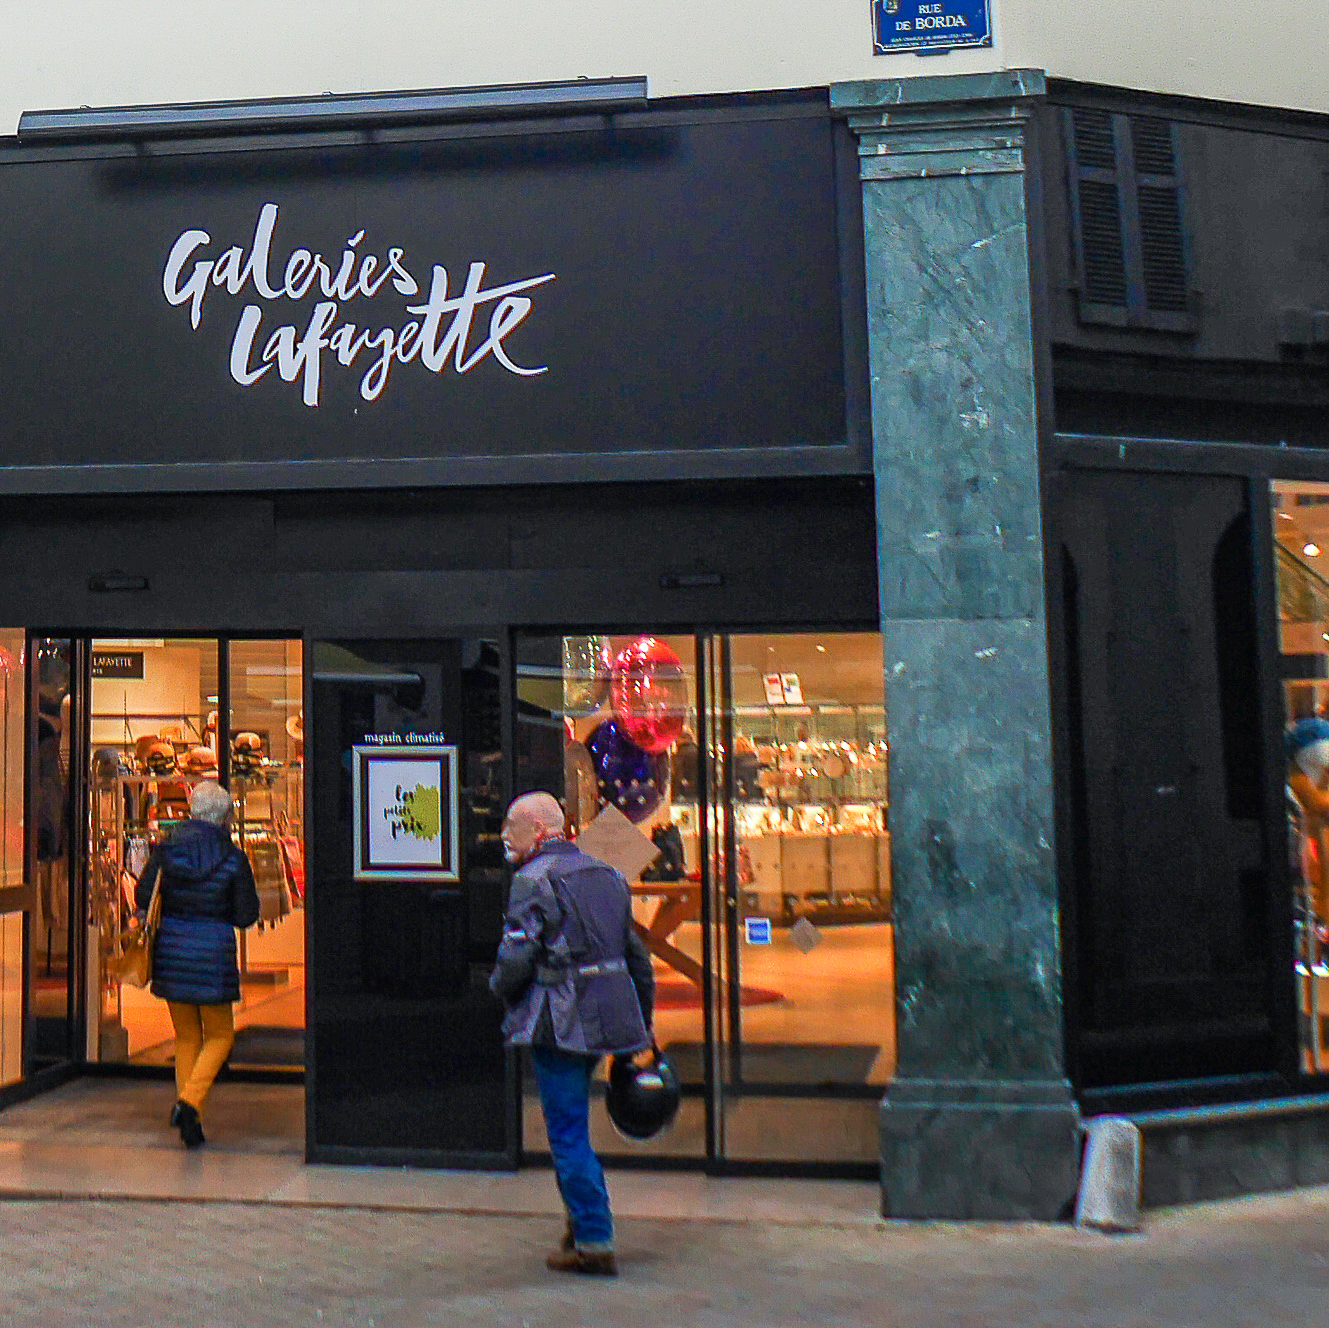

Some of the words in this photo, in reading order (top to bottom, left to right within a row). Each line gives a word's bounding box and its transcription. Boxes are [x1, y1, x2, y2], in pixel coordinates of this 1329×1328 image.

[918, 3, 943, 14] RUE
[895, 20, 912, 31] DE
[915, 14, 968, 30] BORDA
[163, 202, 419, 331] Galeries
[230, 261, 557, 407] Lafayette
[364, 731, 402, 745] magasin
[405, 731, 445, 744] climatisé
[383, 804, 411, 820] petits
[391, 815, 425, 840] prix
